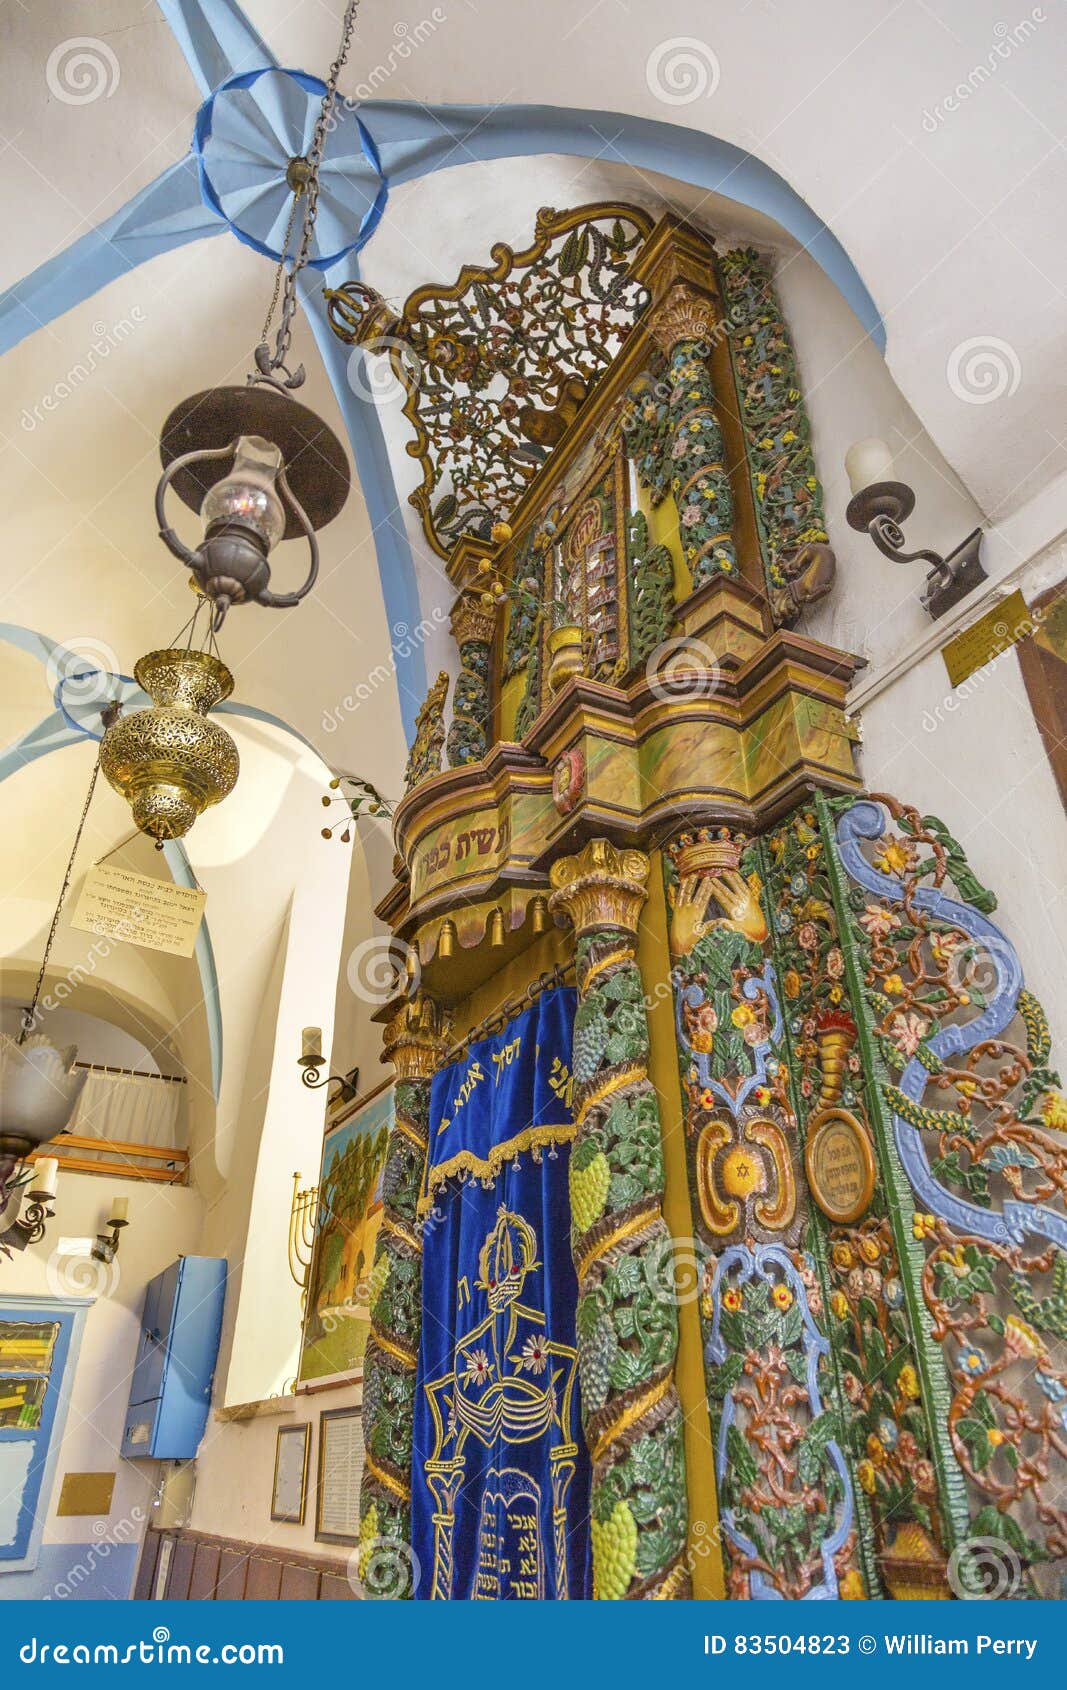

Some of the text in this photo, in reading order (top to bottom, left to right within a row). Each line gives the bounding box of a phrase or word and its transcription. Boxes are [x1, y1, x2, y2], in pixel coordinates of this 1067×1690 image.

[507, 1514, 537, 1530] אנכי
[518, 1530, 537, 1552] לא
[520, 1552, 538, 1575] לא
[509, 1580, 539, 1599] זכור
